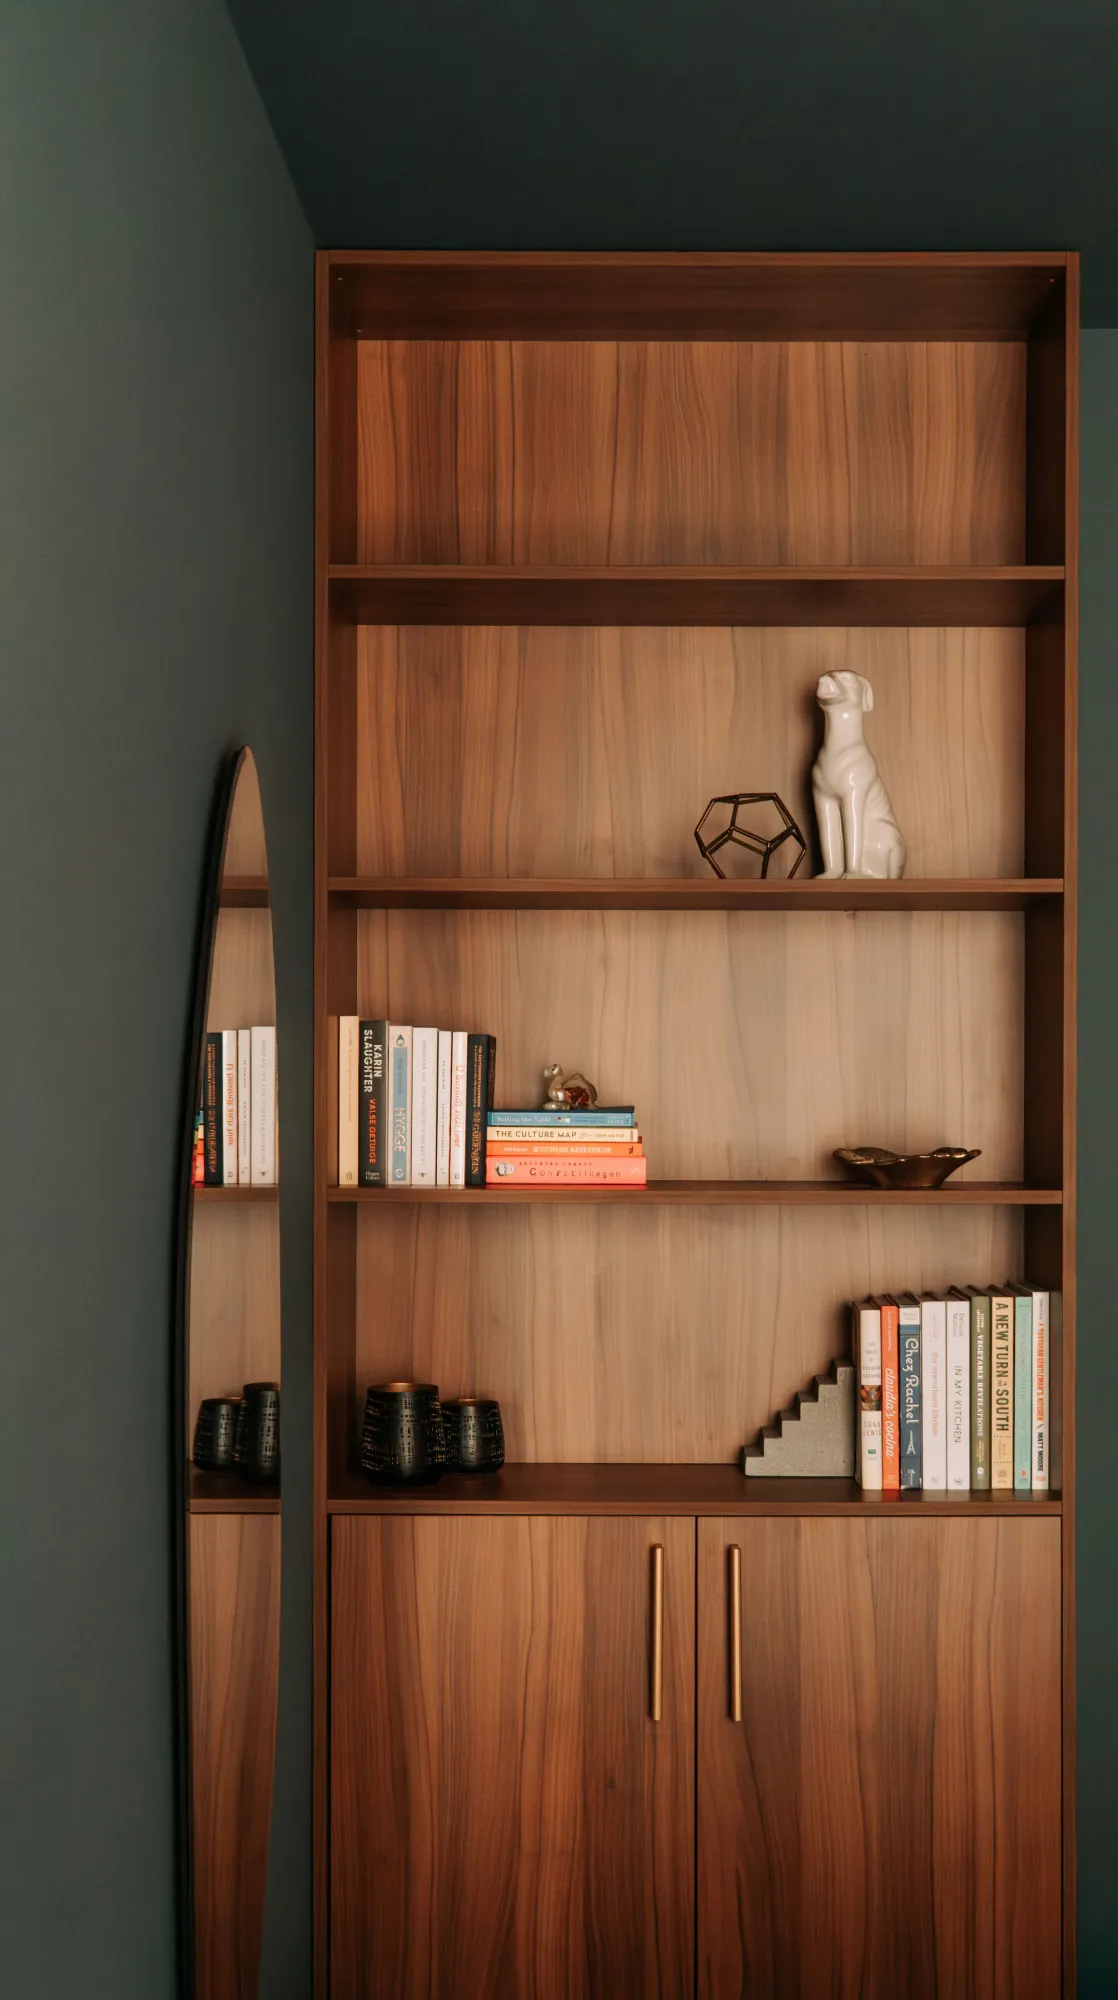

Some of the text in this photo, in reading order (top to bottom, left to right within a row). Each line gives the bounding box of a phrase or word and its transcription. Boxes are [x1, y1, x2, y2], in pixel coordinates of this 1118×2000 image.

[364, 1029, 373, 1093] SLAUGHTER
[374, 1044, 382, 1078] KARIN
[394, 1107, 406, 1152] HYGGE
[903, 1338, 919, 1372] Chez
[976, 1335, 984, 1380] VEGETABLE
[996, 1302, 1009, 1378] A NEW TURN
[885, 1368, 897, 1458] claudia's cocina
[905, 1375, 919, 1423] Rachel
[954, 1365, 962, 1443] IN MY KITCHEN
[976, 1382, 984, 1437] REVELATIONS
[996, 1389, 1009, 1431] SOUTH
[931, 1409, 939, 1437] kitchen
